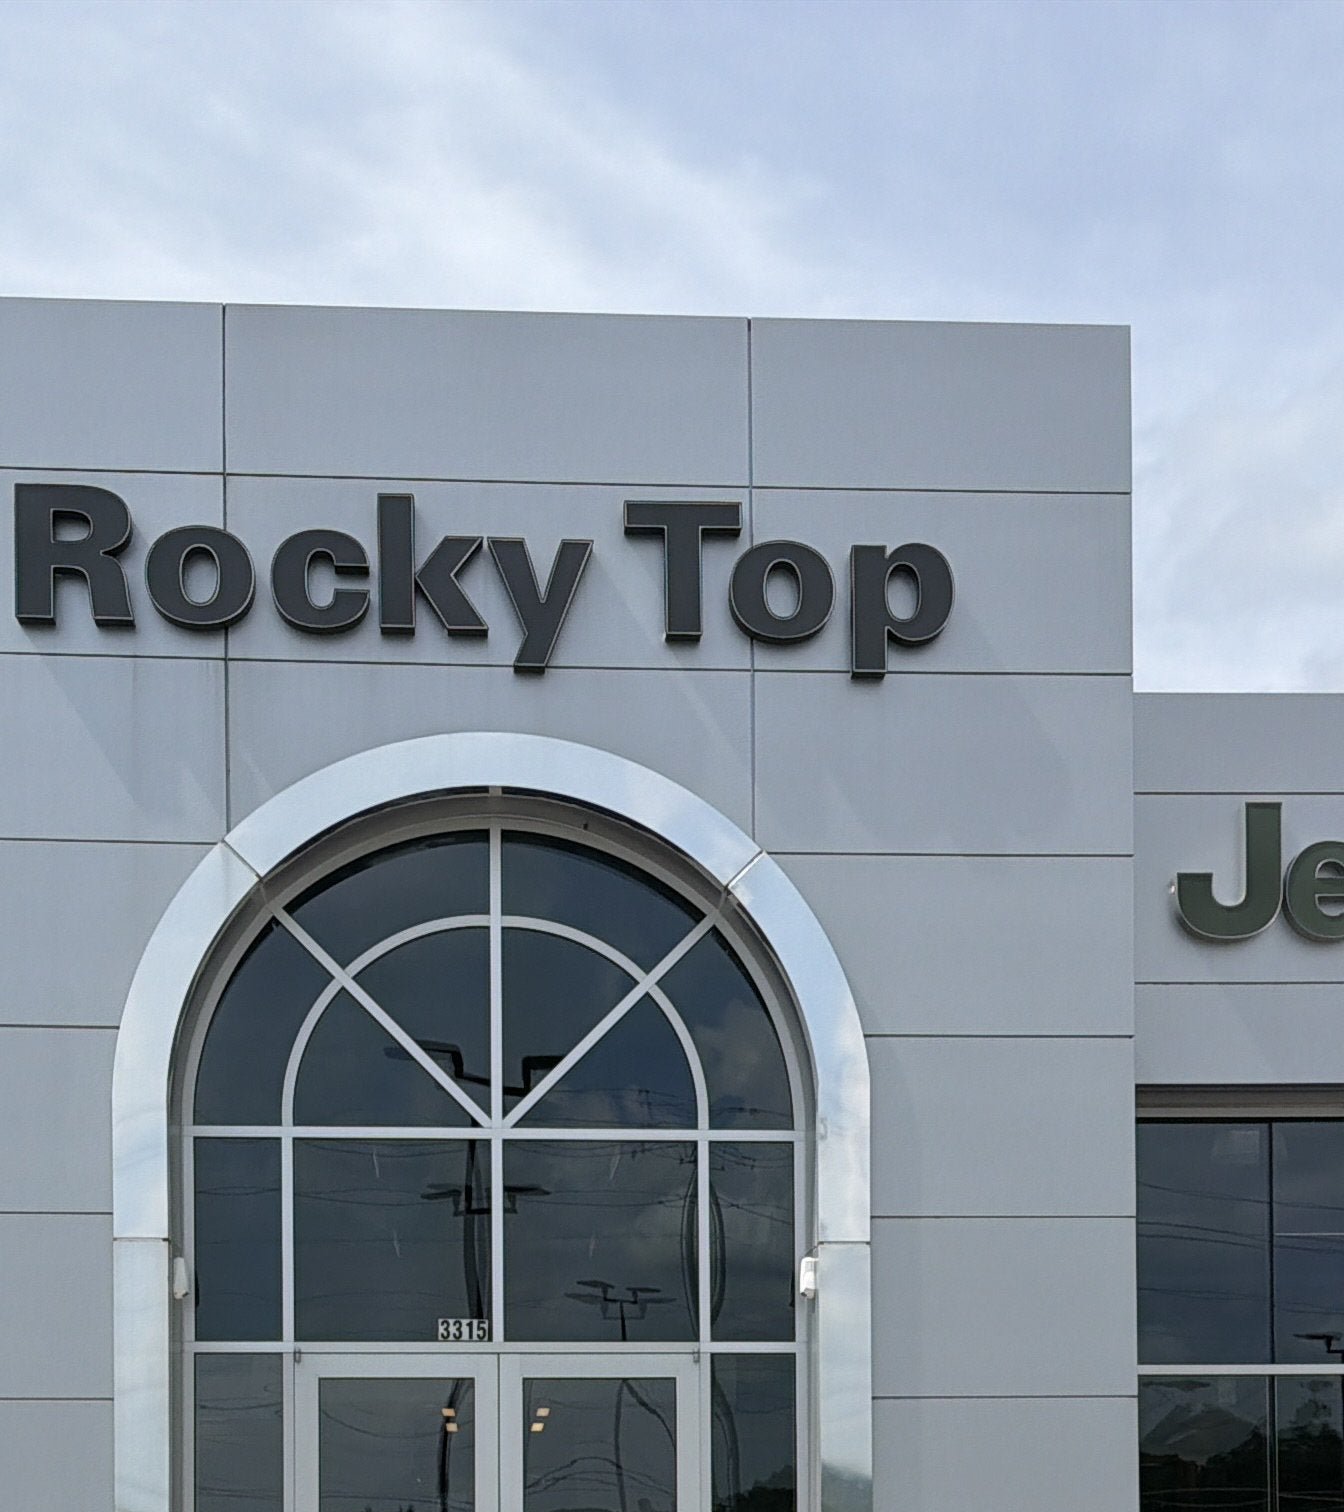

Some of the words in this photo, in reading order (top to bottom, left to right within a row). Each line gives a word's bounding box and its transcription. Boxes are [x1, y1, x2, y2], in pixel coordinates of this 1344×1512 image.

[14, 483, 594, 674] Rocky
[623, 500, 955, 680] Top
[440, 1320, 487, 1340] 3315
